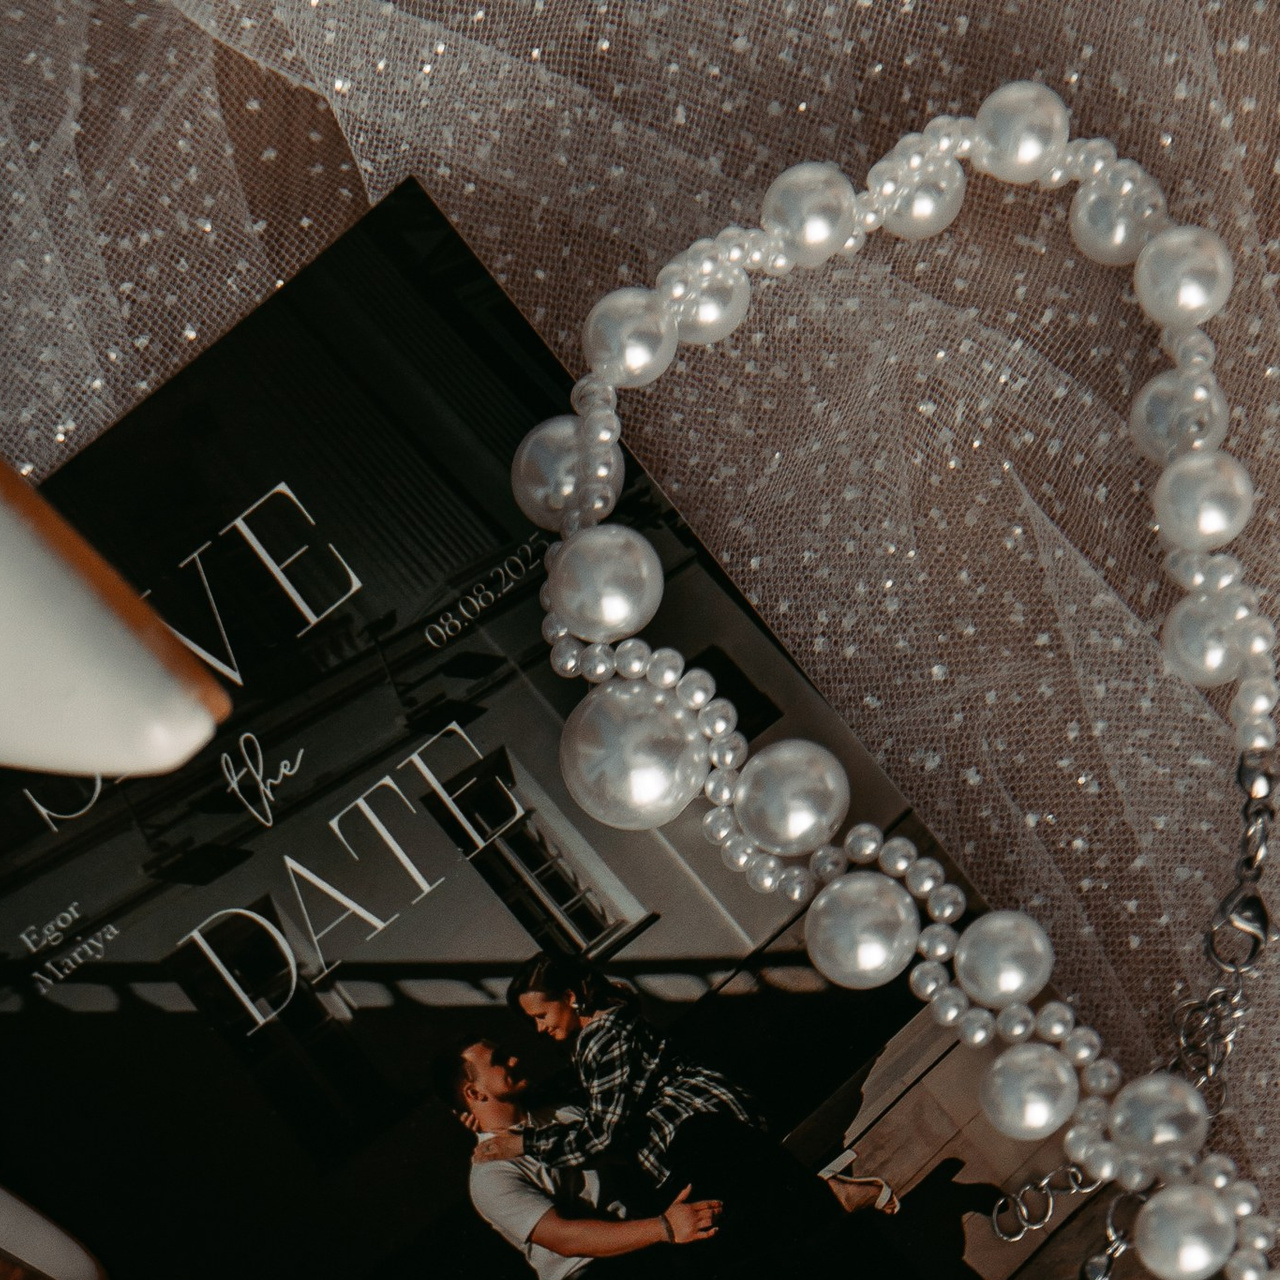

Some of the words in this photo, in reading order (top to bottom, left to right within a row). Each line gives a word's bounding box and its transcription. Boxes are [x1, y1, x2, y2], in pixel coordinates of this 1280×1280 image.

[221, 732, 304, 828] the
[176, 721, 526, 1037] DATE
[19, 901, 82, 954] Egor
[31, 923, 121, 996] Mariya
